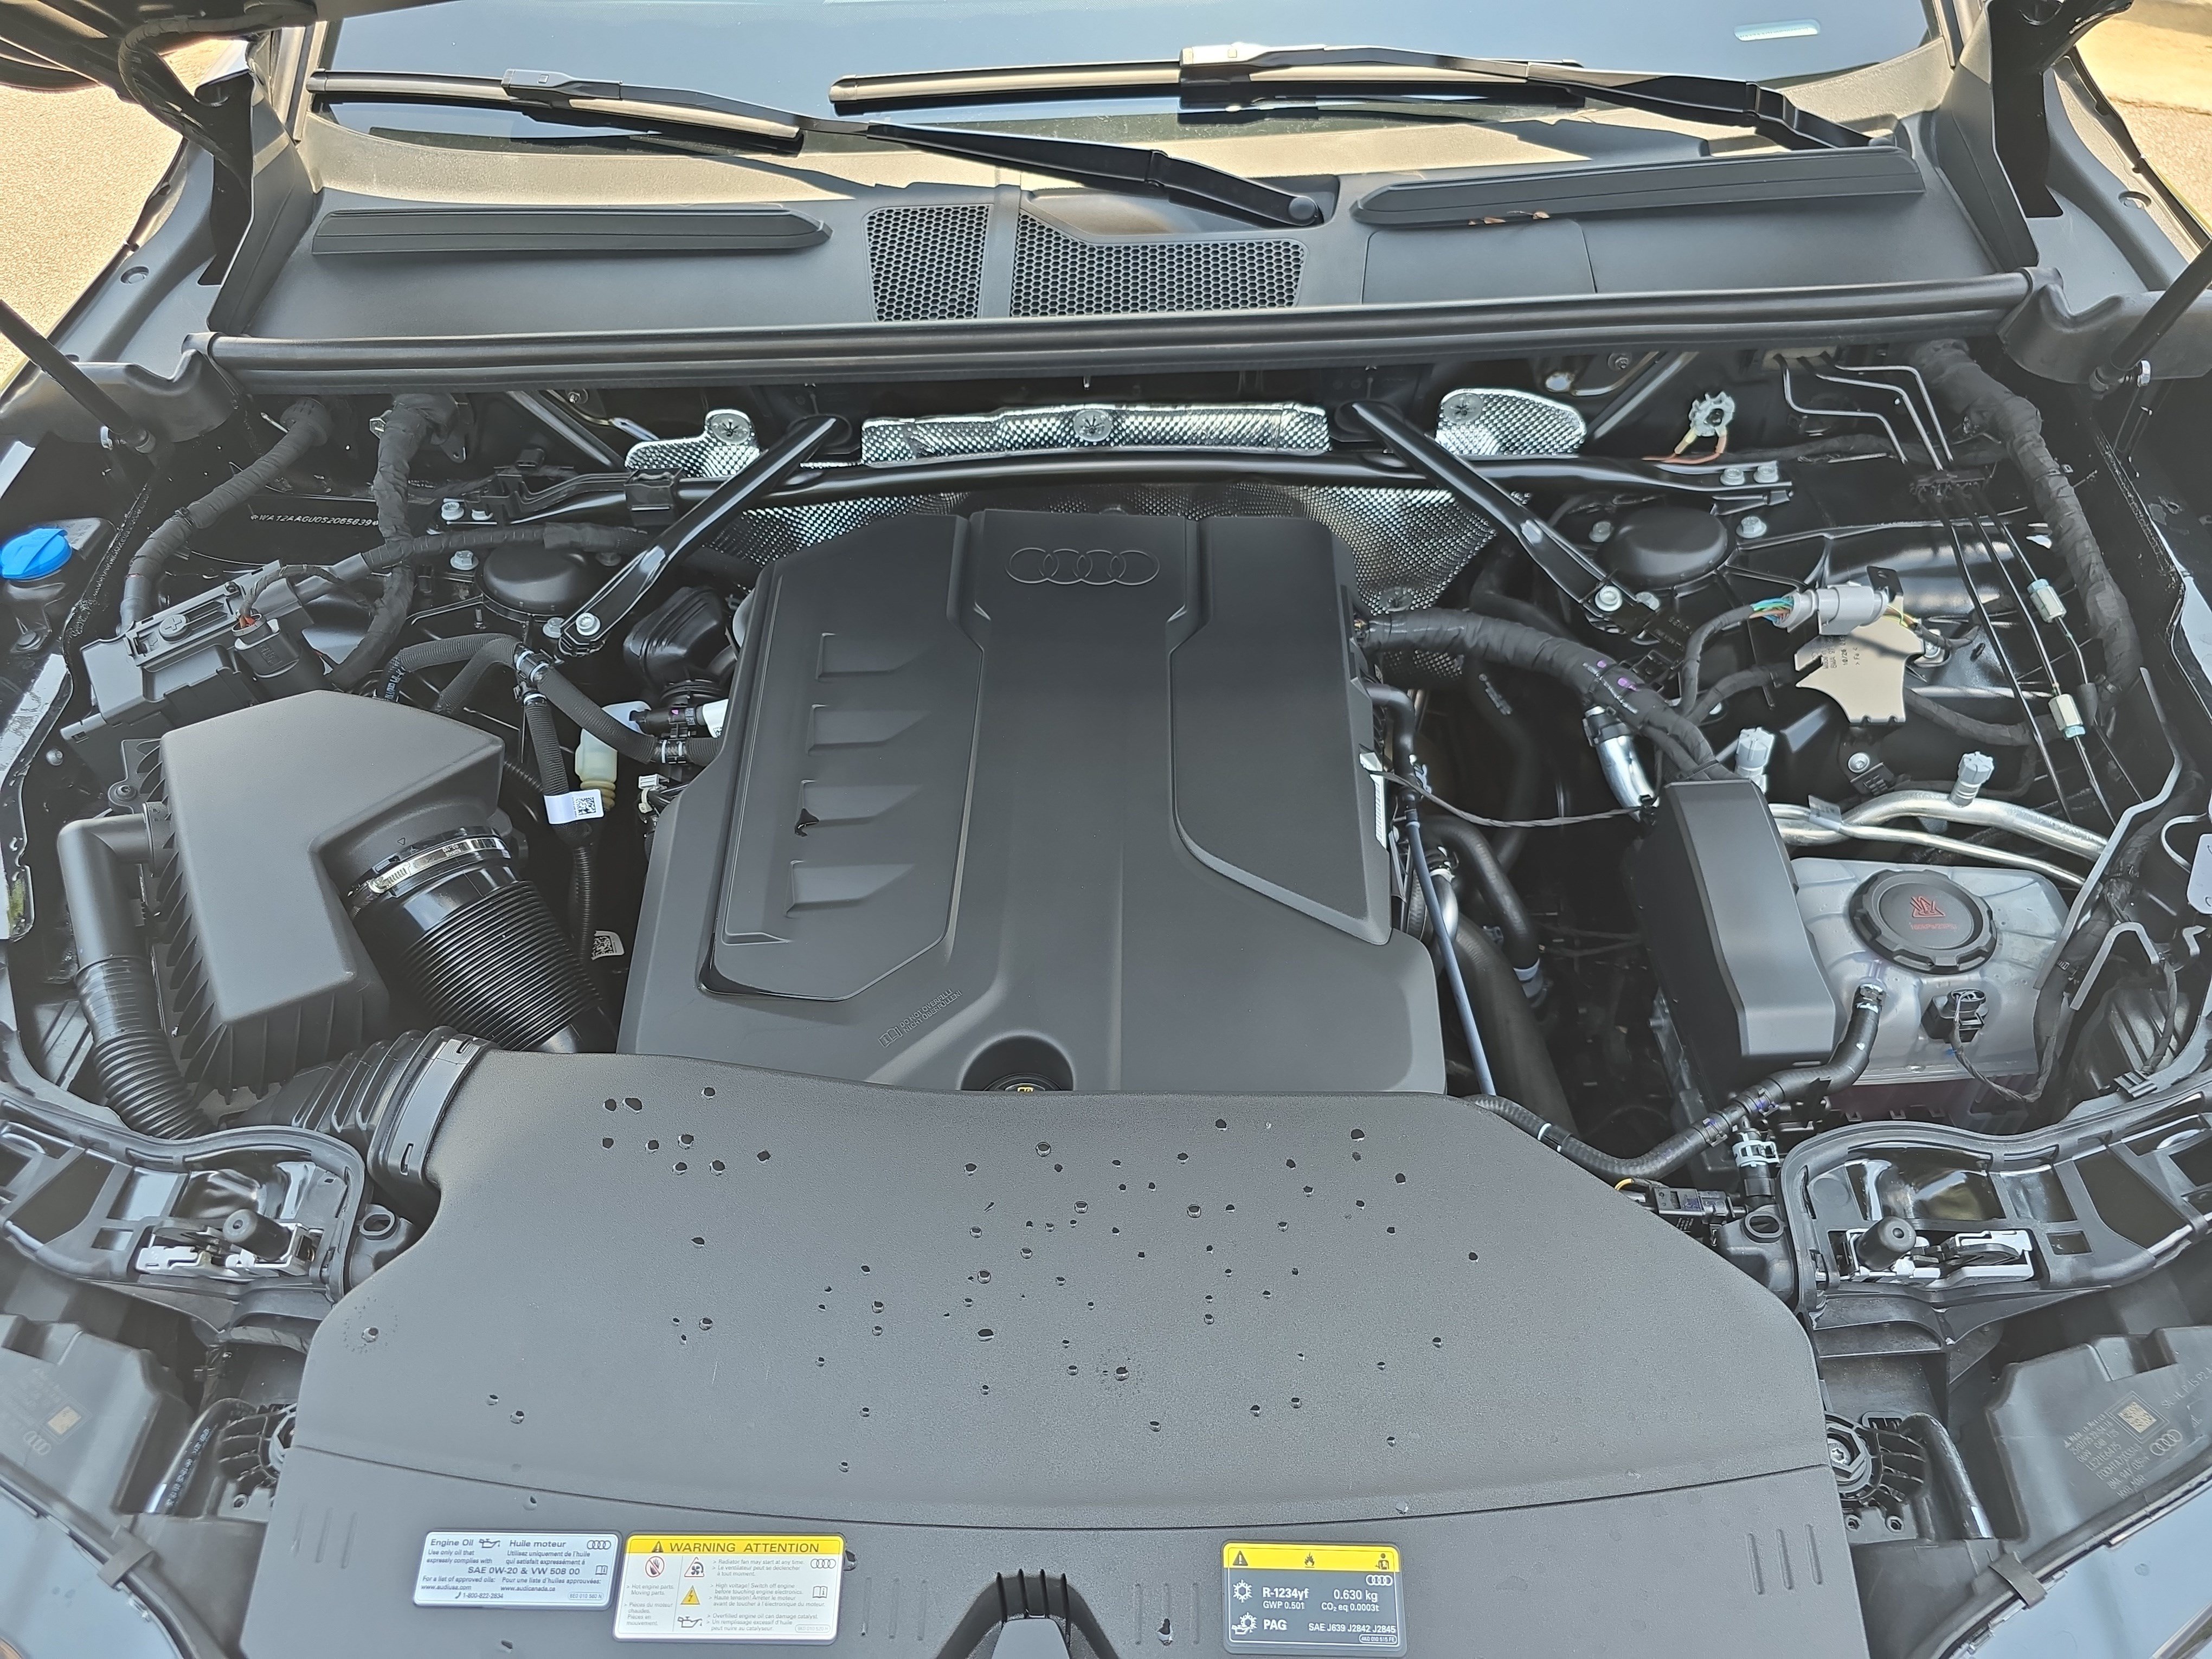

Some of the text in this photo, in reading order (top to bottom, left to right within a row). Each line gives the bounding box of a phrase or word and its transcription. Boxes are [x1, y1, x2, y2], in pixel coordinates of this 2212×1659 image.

[899, 1019, 910, 1028] DO
[909, 1009, 924, 1023] NOT
[670, 1542, 819, 1553] WARNING ATTENTION
[1262, 1586, 1378, 1603] R-1234yf 0.630 kg
[1263, 1601, 1283, 1610] GWP
[1284, 1602, 1305, 1610] 0.501
[1338, 1605, 1349, 1613] eq
[1349, 1604, 1380, 1612] 0.0003t
[1263, 1619, 1288, 1631] PAG
[1308, 1623, 1396, 1633] SAE J639 J2842 J2845
